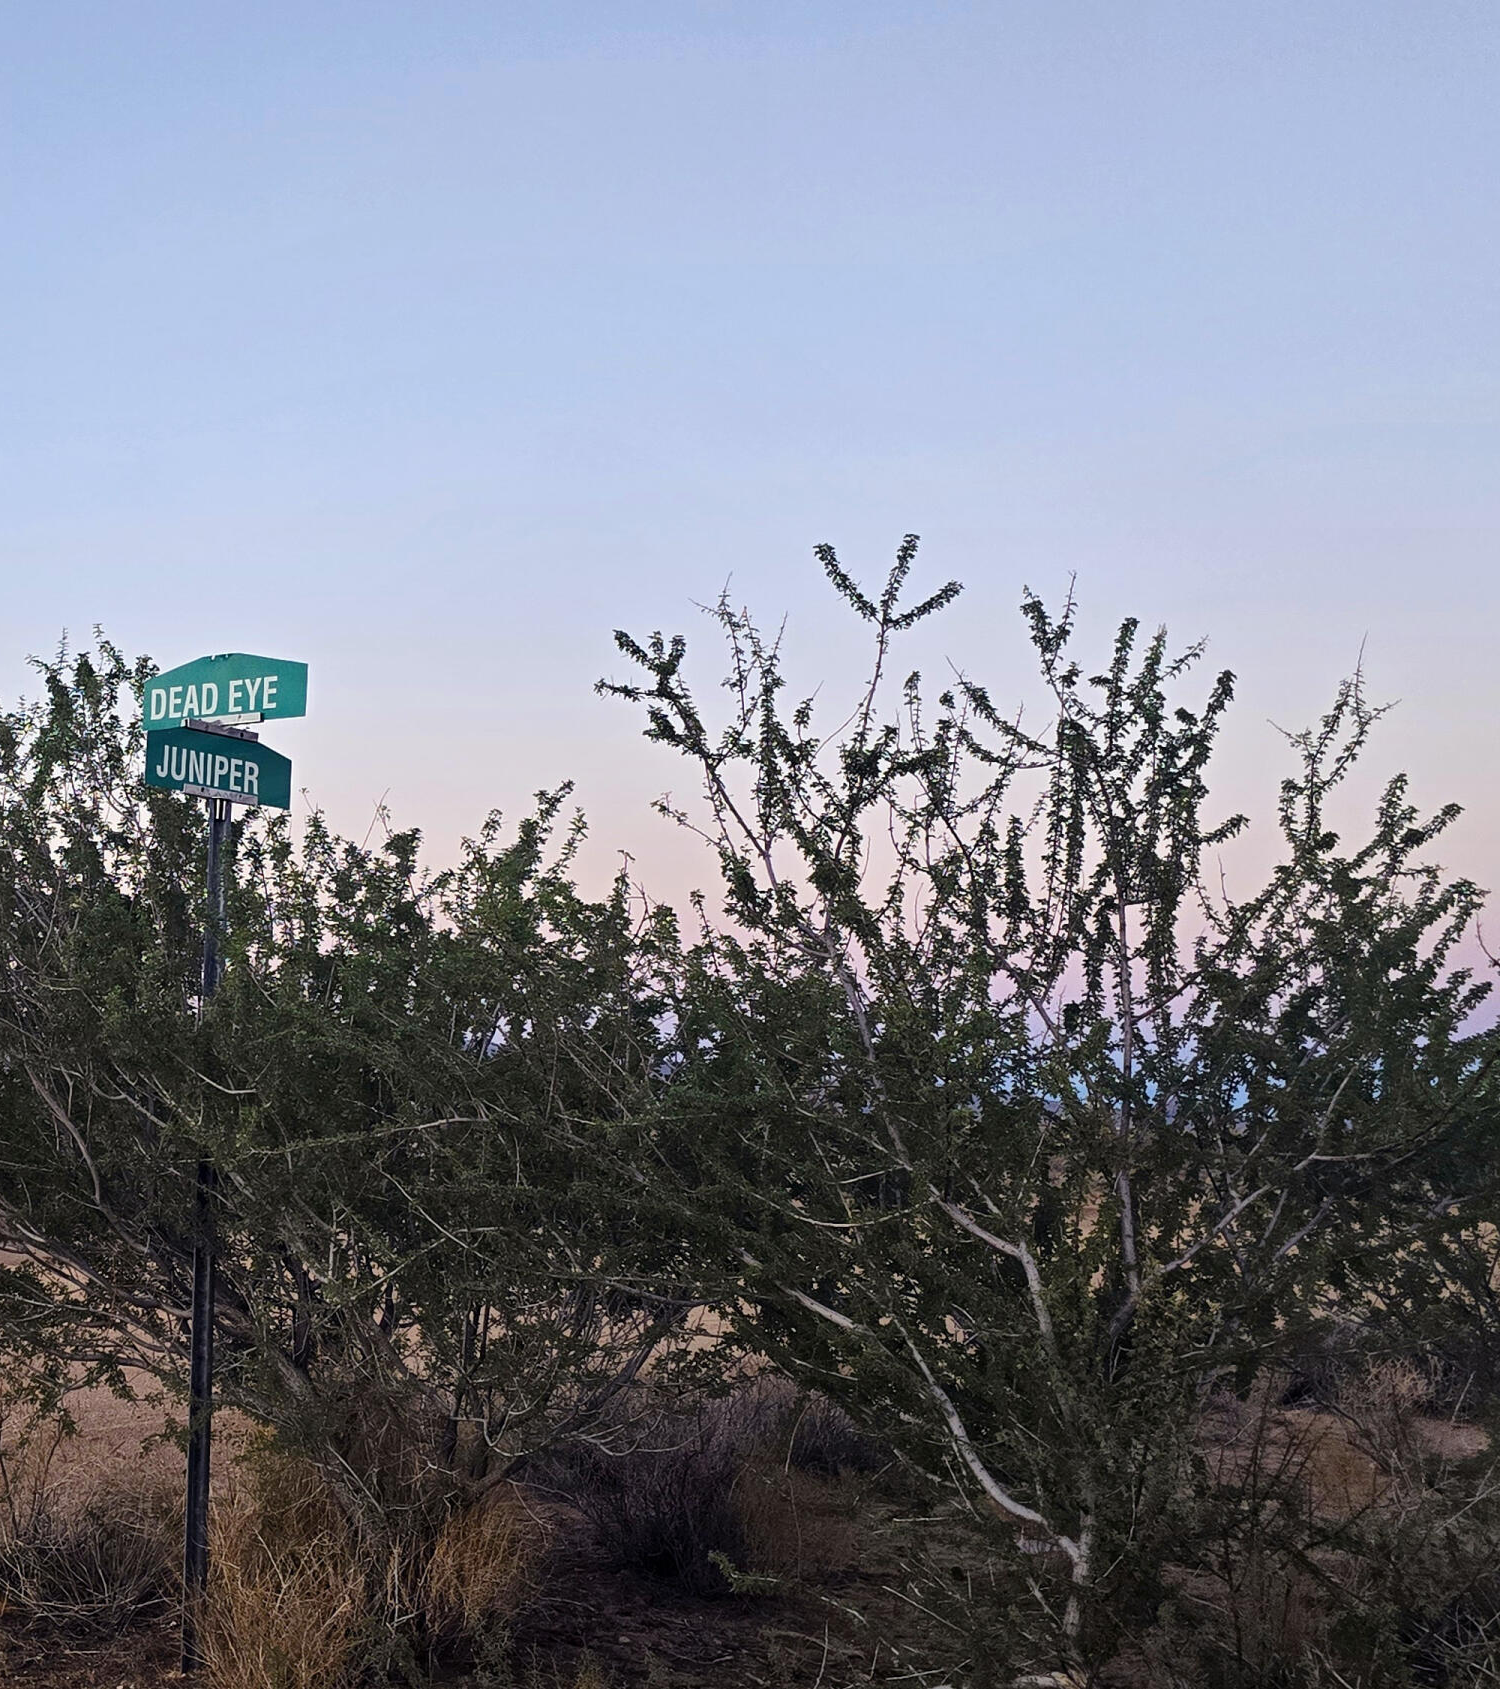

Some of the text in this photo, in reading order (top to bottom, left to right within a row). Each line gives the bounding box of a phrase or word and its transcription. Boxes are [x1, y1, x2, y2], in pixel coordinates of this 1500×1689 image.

[150, 675, 278, 720] DEAD EYE
[156, 744, 259, 795] JUNIPER
